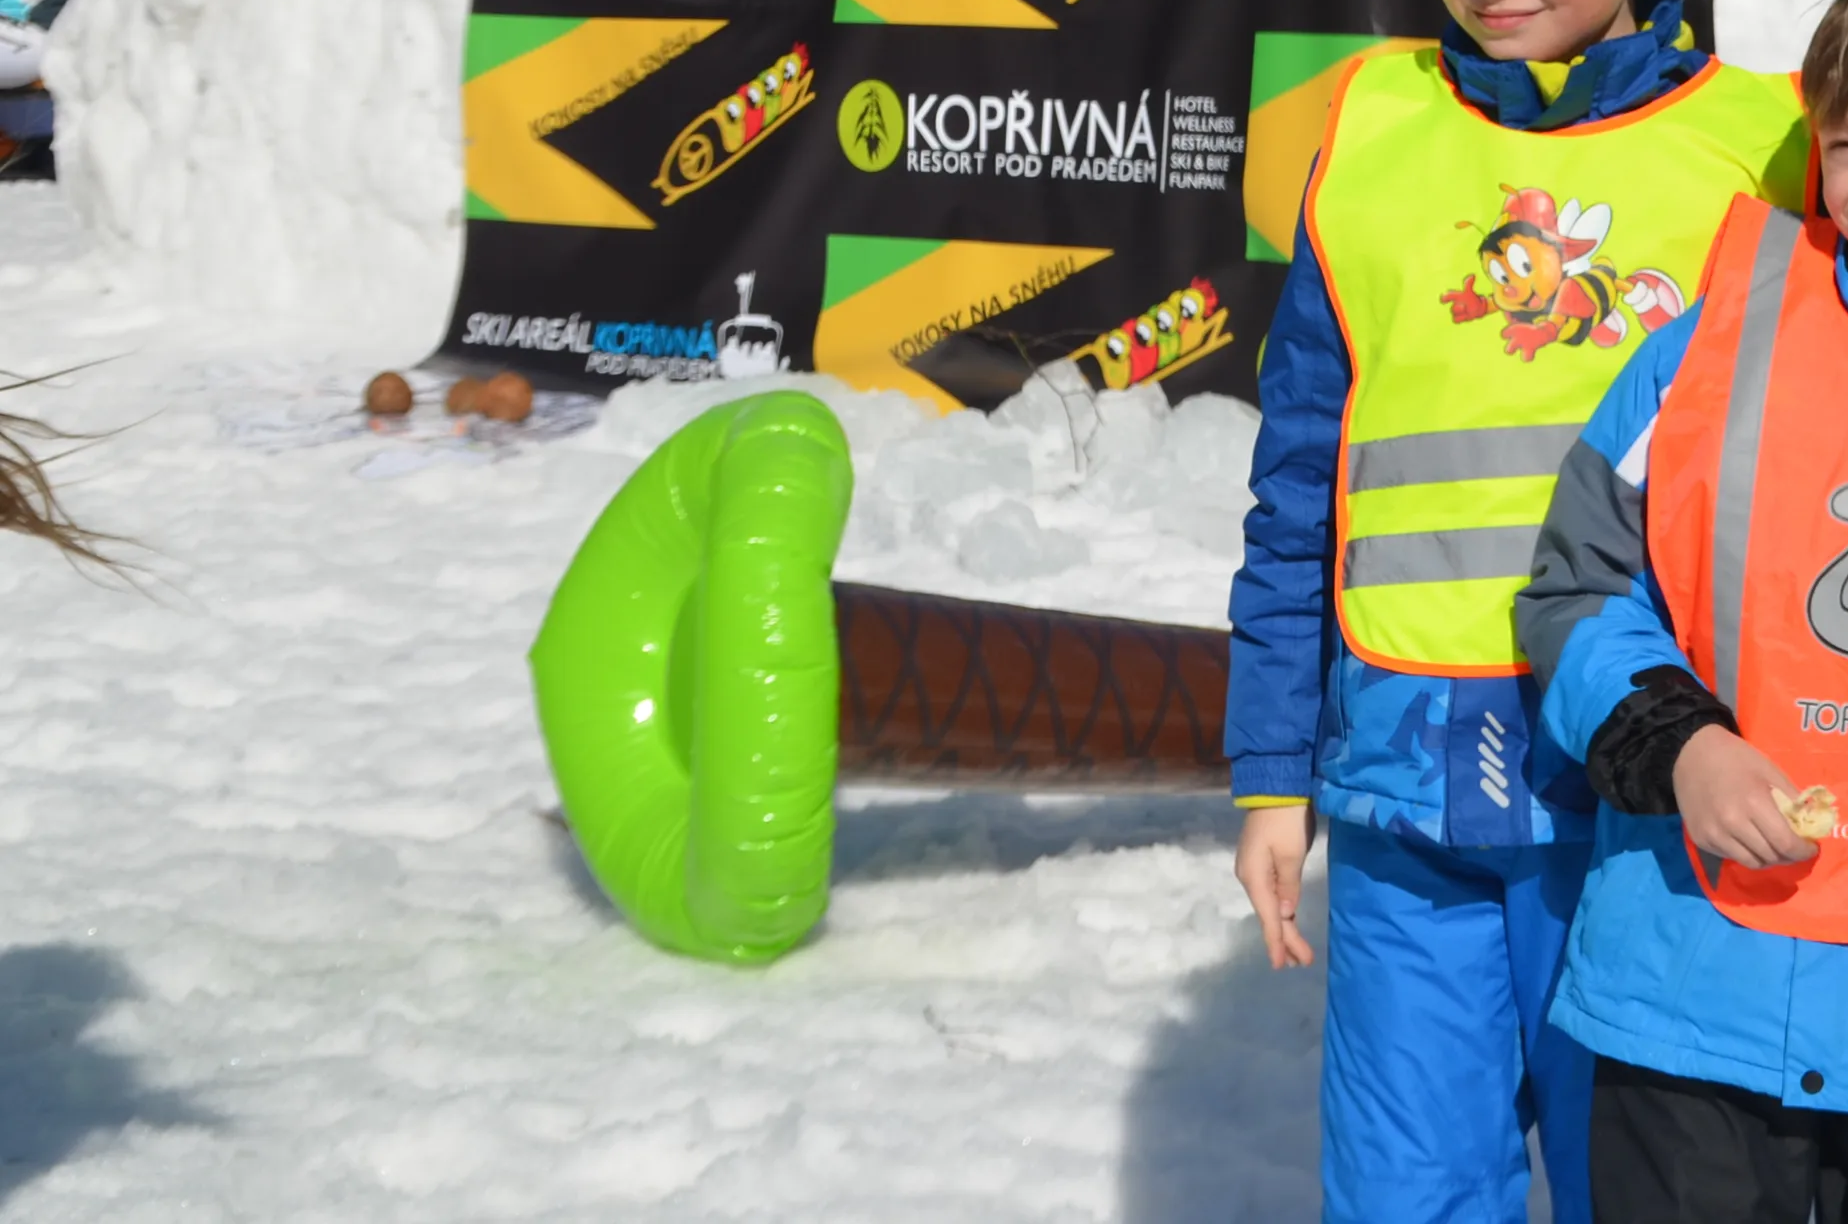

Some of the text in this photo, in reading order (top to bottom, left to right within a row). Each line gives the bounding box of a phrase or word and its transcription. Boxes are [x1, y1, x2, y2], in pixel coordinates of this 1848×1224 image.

[1174, 96, 1217, 114] HOTEL
[908, 88, 1157, 159] KOPŘIVNÁ
[1172, 114, 1235, 133] WELLNESS
[1171, 133, 1245, 153] RESTAURACE
[907, 150, 986, 175] RESORT
[995, 152, 1042, 178] POD
[1170, 152, 1192, 169] SKI
[1206, 154, 1230, 172] BIKE
[1168, 171, 1226, 190] FUNPARK
[462, 312, 512, 346] SKI
[505, 312, 594, 353] AREÁL
[889, 309, 962, 364] KOKOSY
[970, 294, 1004, 326] NA
